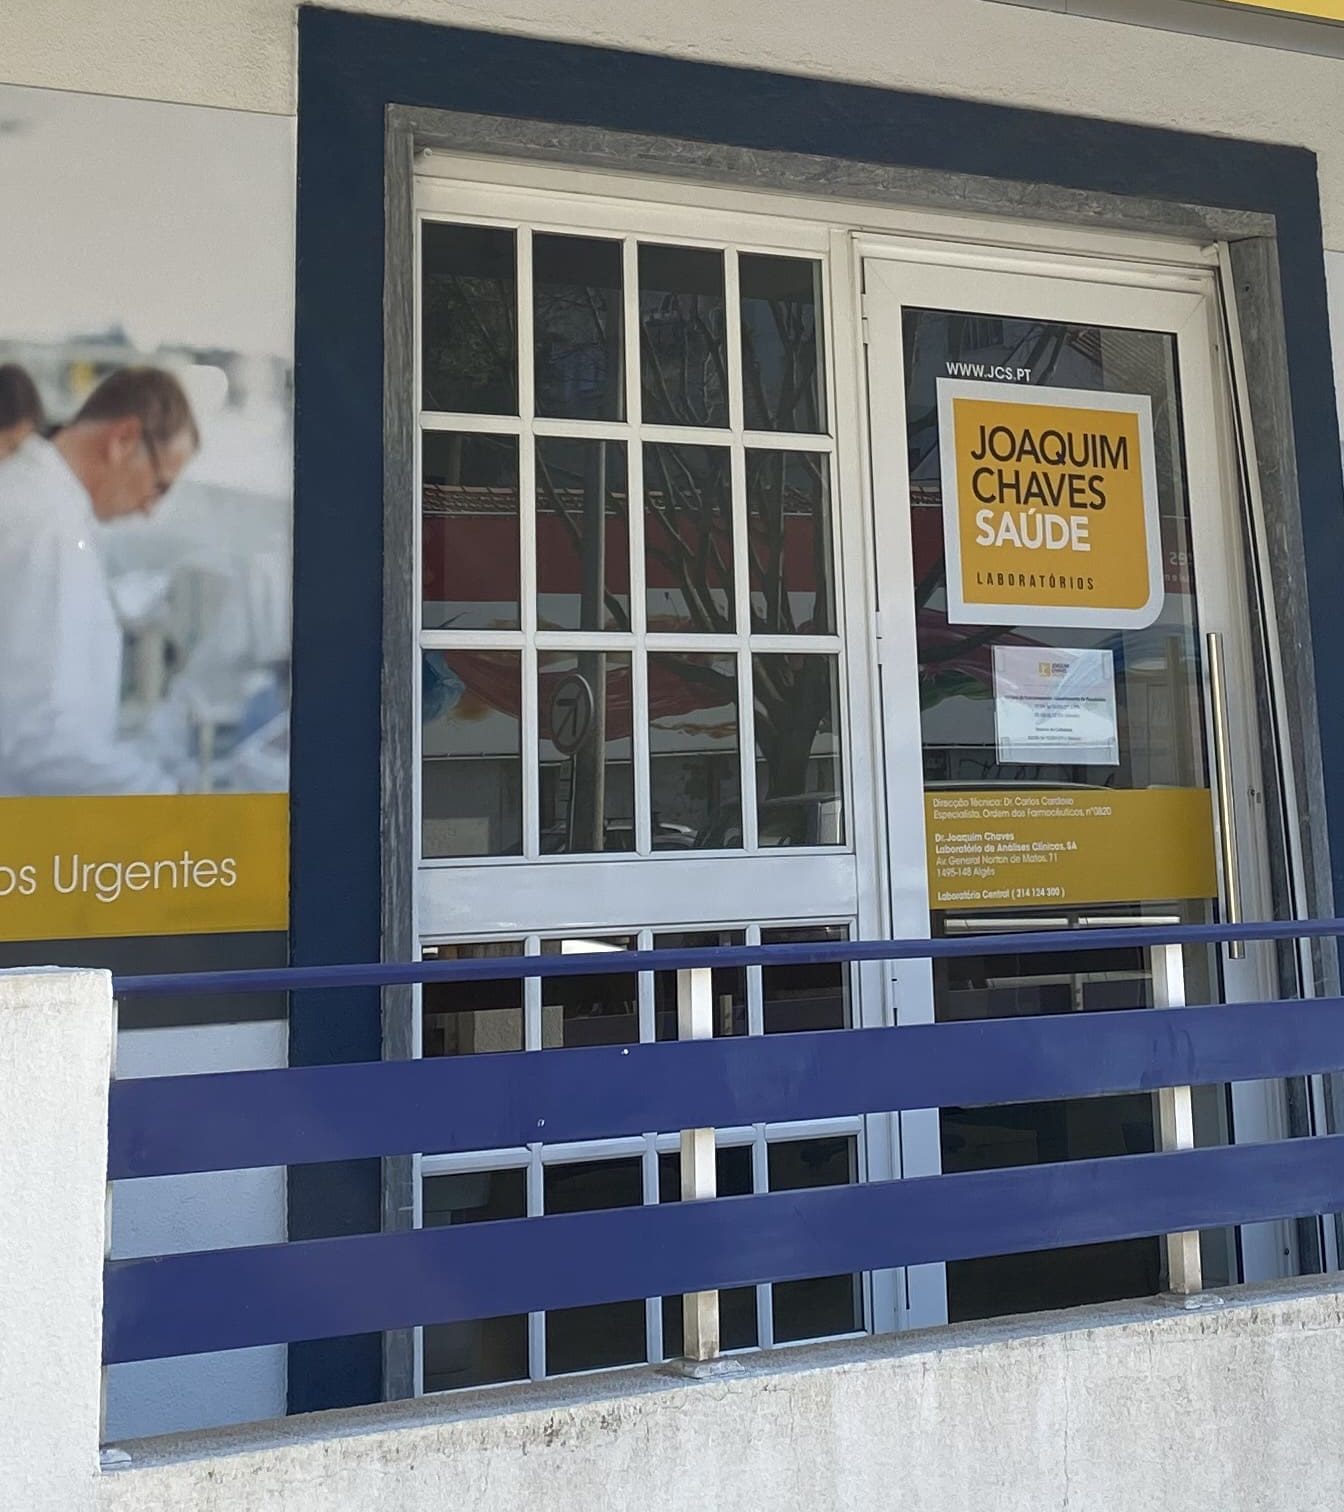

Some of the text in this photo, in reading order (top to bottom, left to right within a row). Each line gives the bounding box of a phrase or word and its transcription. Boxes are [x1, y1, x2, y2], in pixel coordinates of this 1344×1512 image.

[946, 361, 1032, 383] WWW.JCS.PT
[971, 425, 1129, 470] JOAQUIM
[972, 467, 1107, 510] CHAVES
[975, 509, 1091, 552] SAÚDE
[977, 571, 1095, 591] LABORATÓRIOS
[936, 843, 982, 854] Laboratório
[997, 842, 1030, 852] Análises
[946, 832, 982, 842] Joaquim
[984, 832, 1014, 841] Chaves
[53, 850, 238, 903] Urgentes
[937, 890, 981, 901] Laboratório
